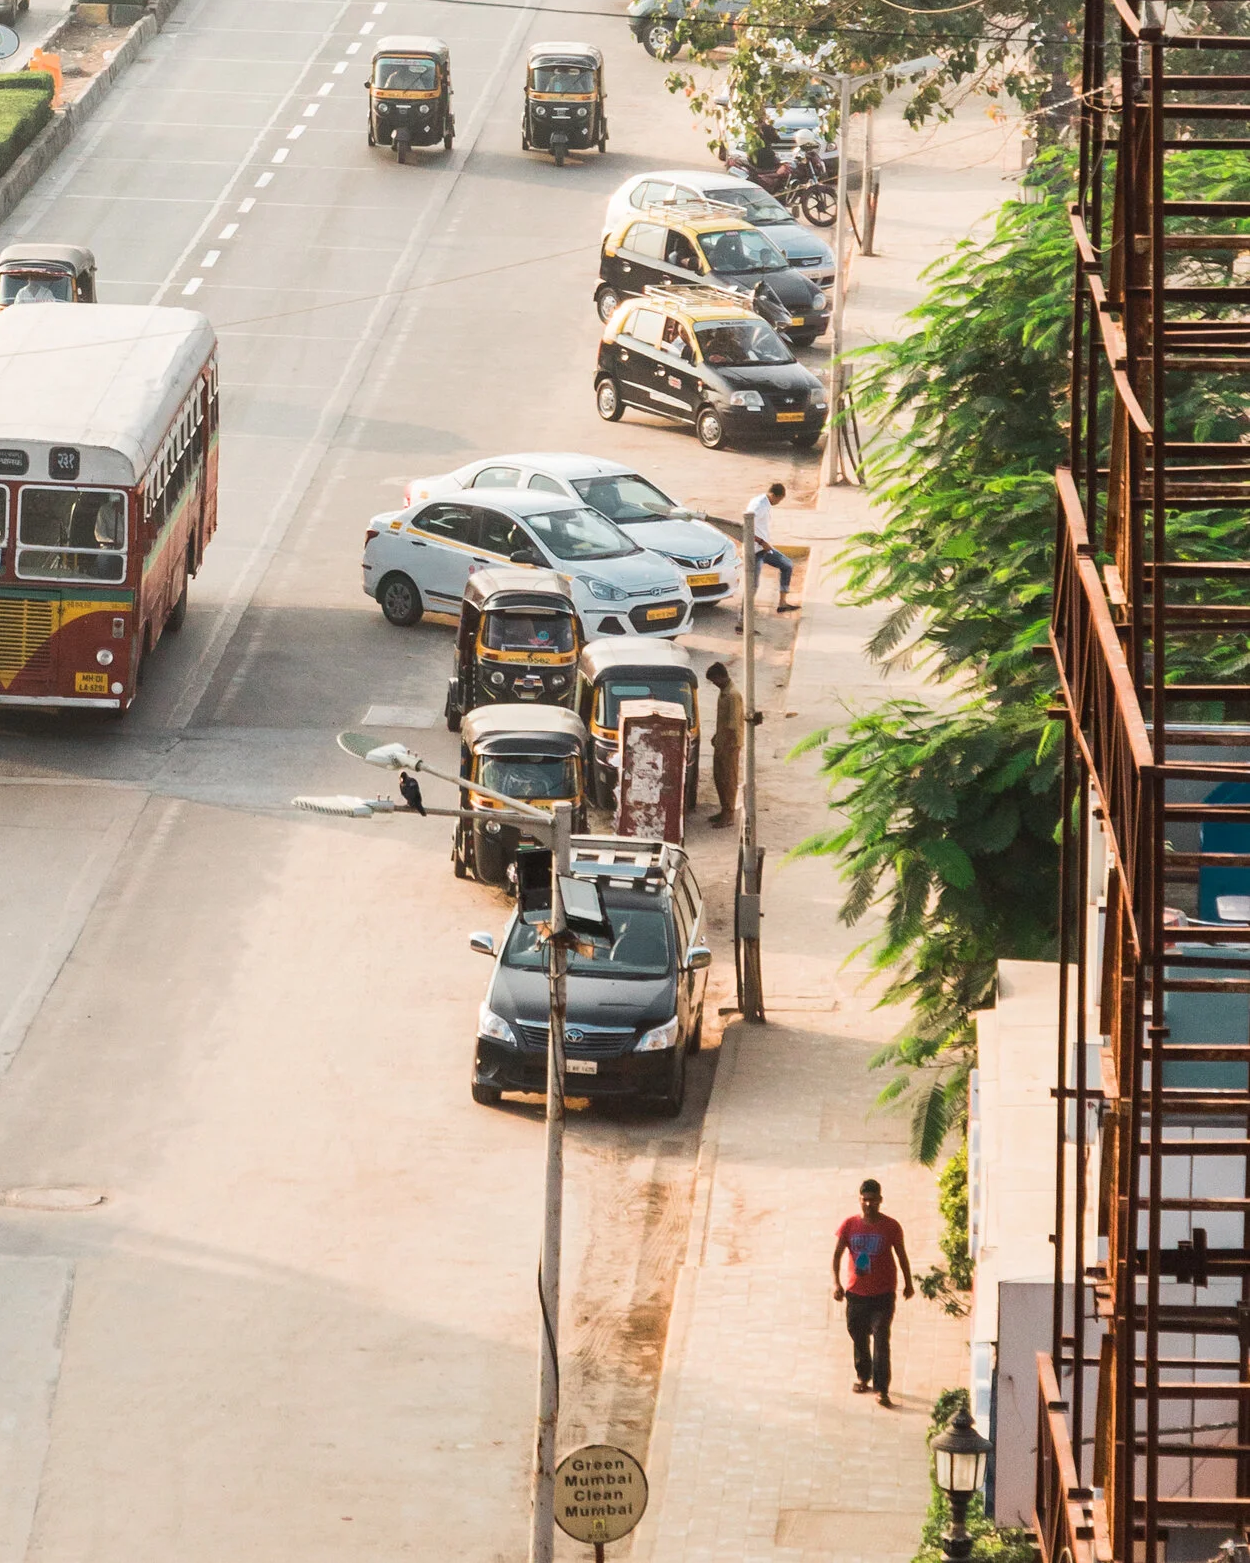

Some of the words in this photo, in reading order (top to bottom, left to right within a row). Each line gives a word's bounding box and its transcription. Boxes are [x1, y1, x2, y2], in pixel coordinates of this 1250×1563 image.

[572, 1460, 624, 1471] Green
[565, 1473, 632, 1486] Mumbai
[574, 1490, 623, 1501] Clean
[565, 1503, 632, 1517] Mumbai
